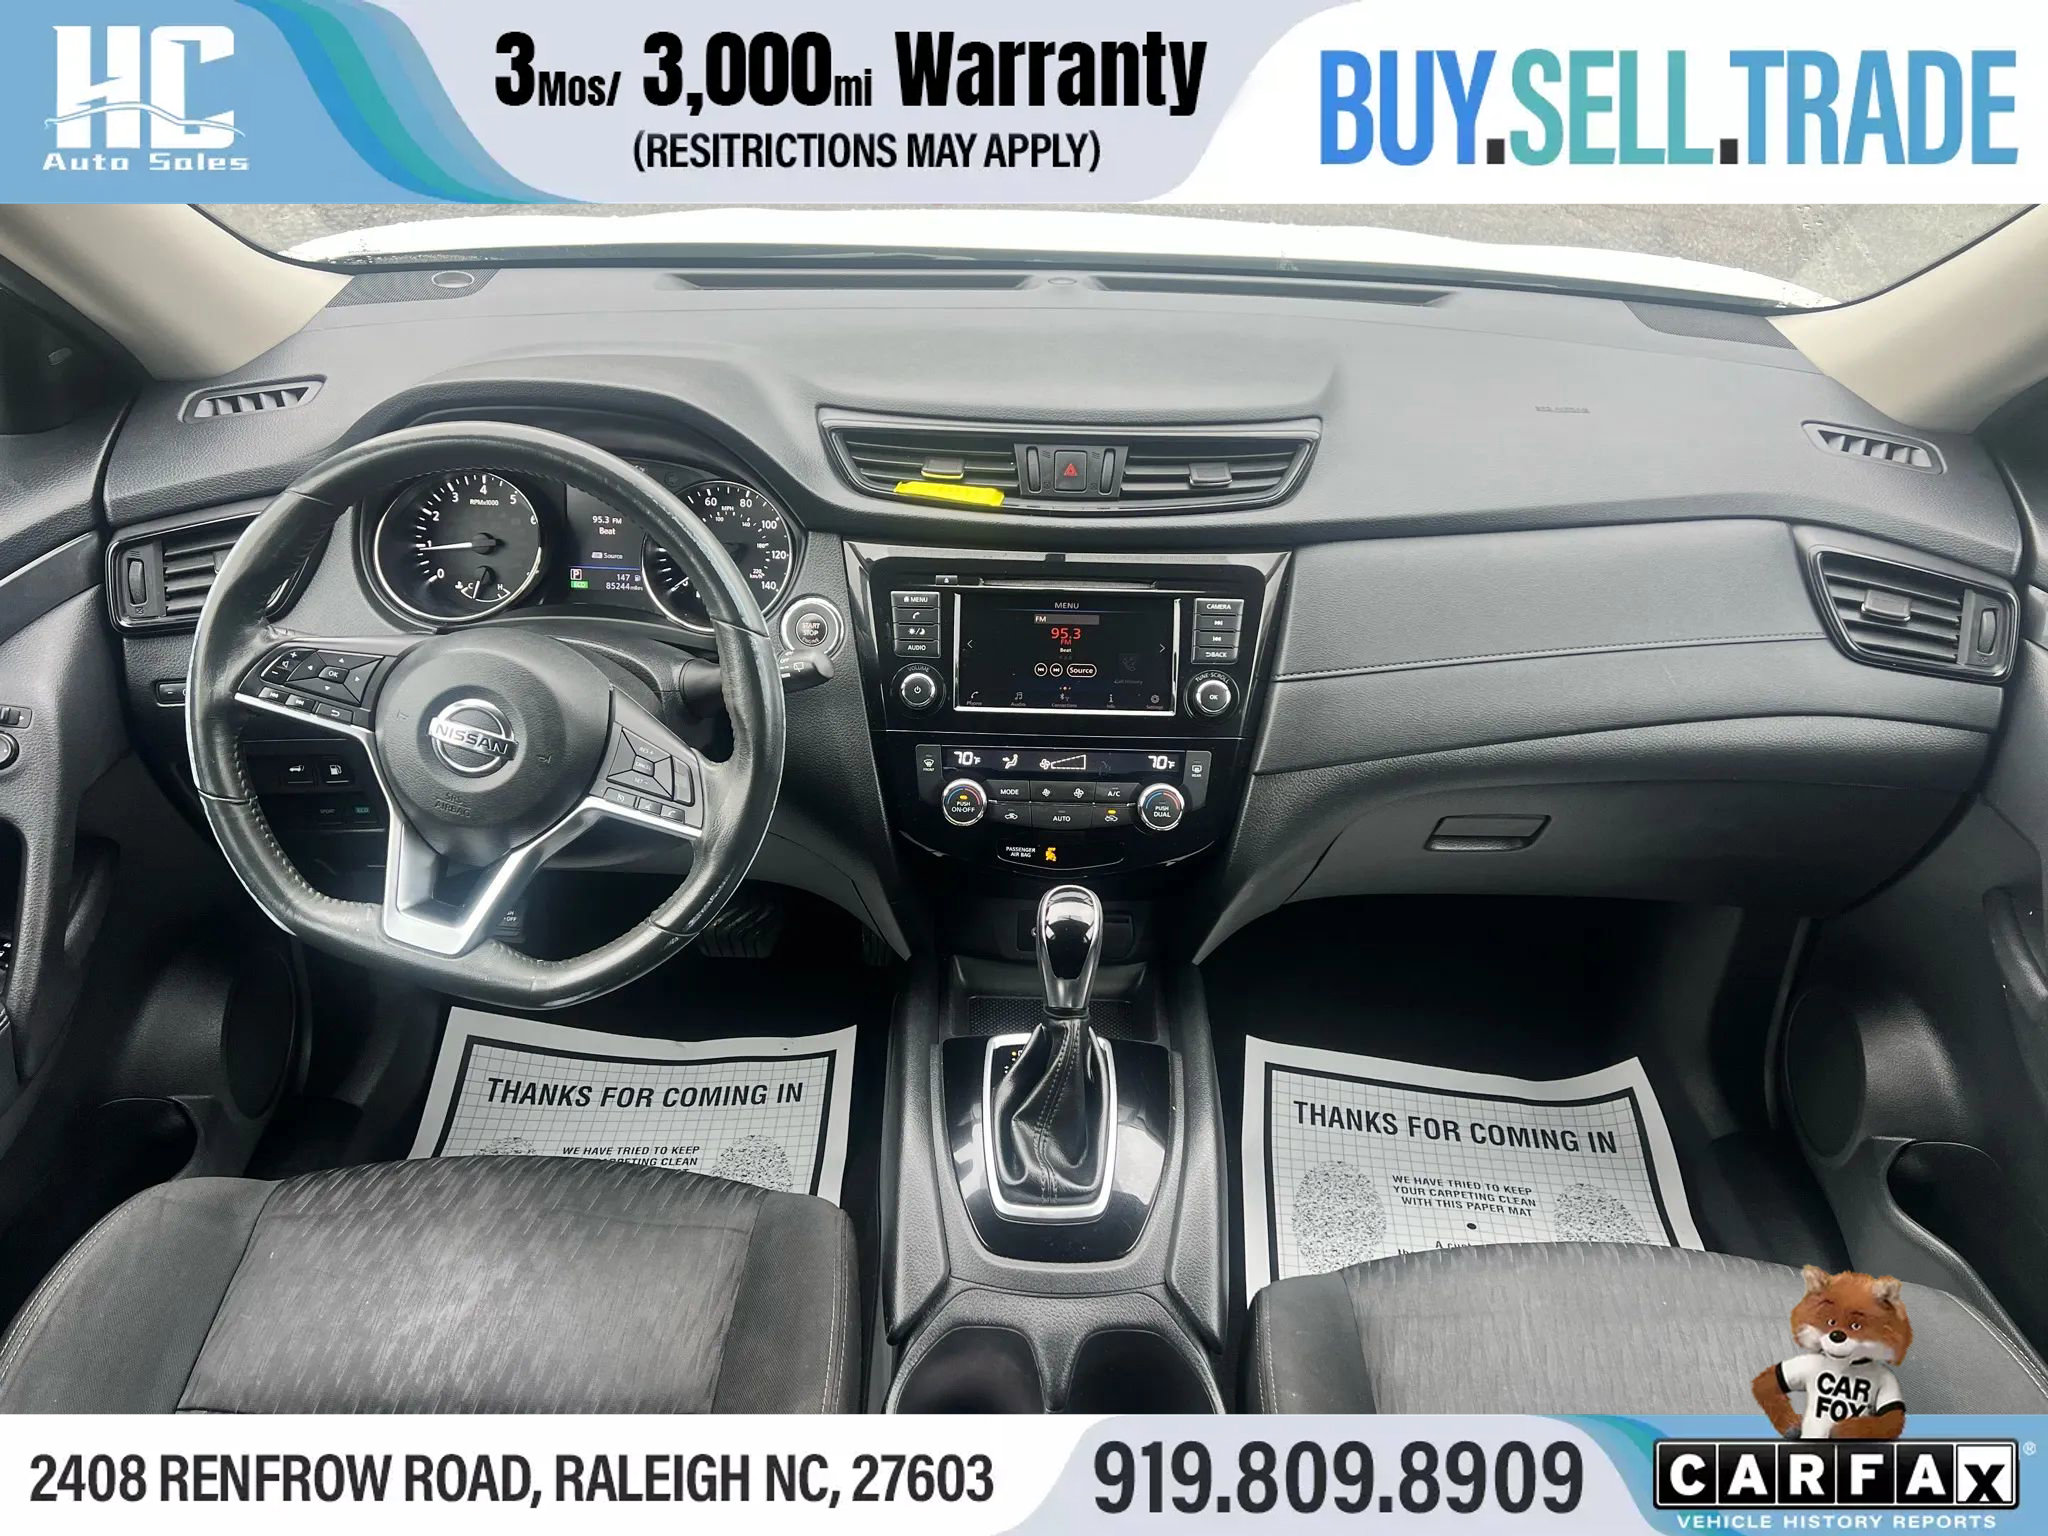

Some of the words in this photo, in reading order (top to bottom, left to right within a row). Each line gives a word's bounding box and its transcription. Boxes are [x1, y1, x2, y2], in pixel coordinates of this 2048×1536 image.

[479, 484, 488, 495] 4
[452, 491, 459, 502] 3
[509, 494, 517, 505] 5
[704, 497, 717, 507] 60
[739, 498, 752, 508] 80
[432, 511, 440, 522] 2
[592, 515, 610, 524] 95.3
[761, 520, 777, 529] 100
[599, 527, 616, 535] Beat
[771, 550, 786, 560] 120
[436, 568, 445, 579] 0
[616, 573, 631, 581] 147
[761, 580, 776, 590] 140
[1035, 615, 1047, 623] FM
[1051, 627, 1081, 640] 95.3
[328, 670, 339, 679] OK
[1069, 666, 1094, 674] Source
[436, 723, 509, 755] NISSAN
[486, 1077, 593, 1107] THANKS
[600, 1086, 652, 1108] FOR
[662, 1084, 767, 1108] COMING
[776, 1082, 803, 1103] IN
[1293, 1100, 1399, 1136] THANKS
[1408, 1116, 1461, 1143] FOR
[1470, 1122, 1580, 1153] COMING
[1587, 1131, 1617, 1154] IN
[562, 1146, 581, 1155] WE
[583, 1146, 613, 1156] HAVE
[617, 1146, 650, 1155] TRIED
[654, 1146, 668, 1155] TO
[671, 1145, 700, 1155] KEEP
[661, 1157, 698, 1166] CLEAN
[1392, 1175, 1411, 1184] WE
[1414, 1177, 1443, 1187] HAVE
[1448, 1179, 1481, 1190] TRIED
[1485, 1183, 1500, 1192] TO
[1504, 1185, 1532, 1196] KEEP
[1393, 1185, 1426, 1196] YOUR
[1429, 1188, 1495, 1202] CARPETING
[1498, 1195, 1536, 1207] CLEAN
[1401, 1196, 1432, 1207] WITH
[1436, 1199, 1463, 1209] THIS
[1467, 1201, 1504, 1213] PAPER
[1508, 1207, 1533, 1217] MAT
